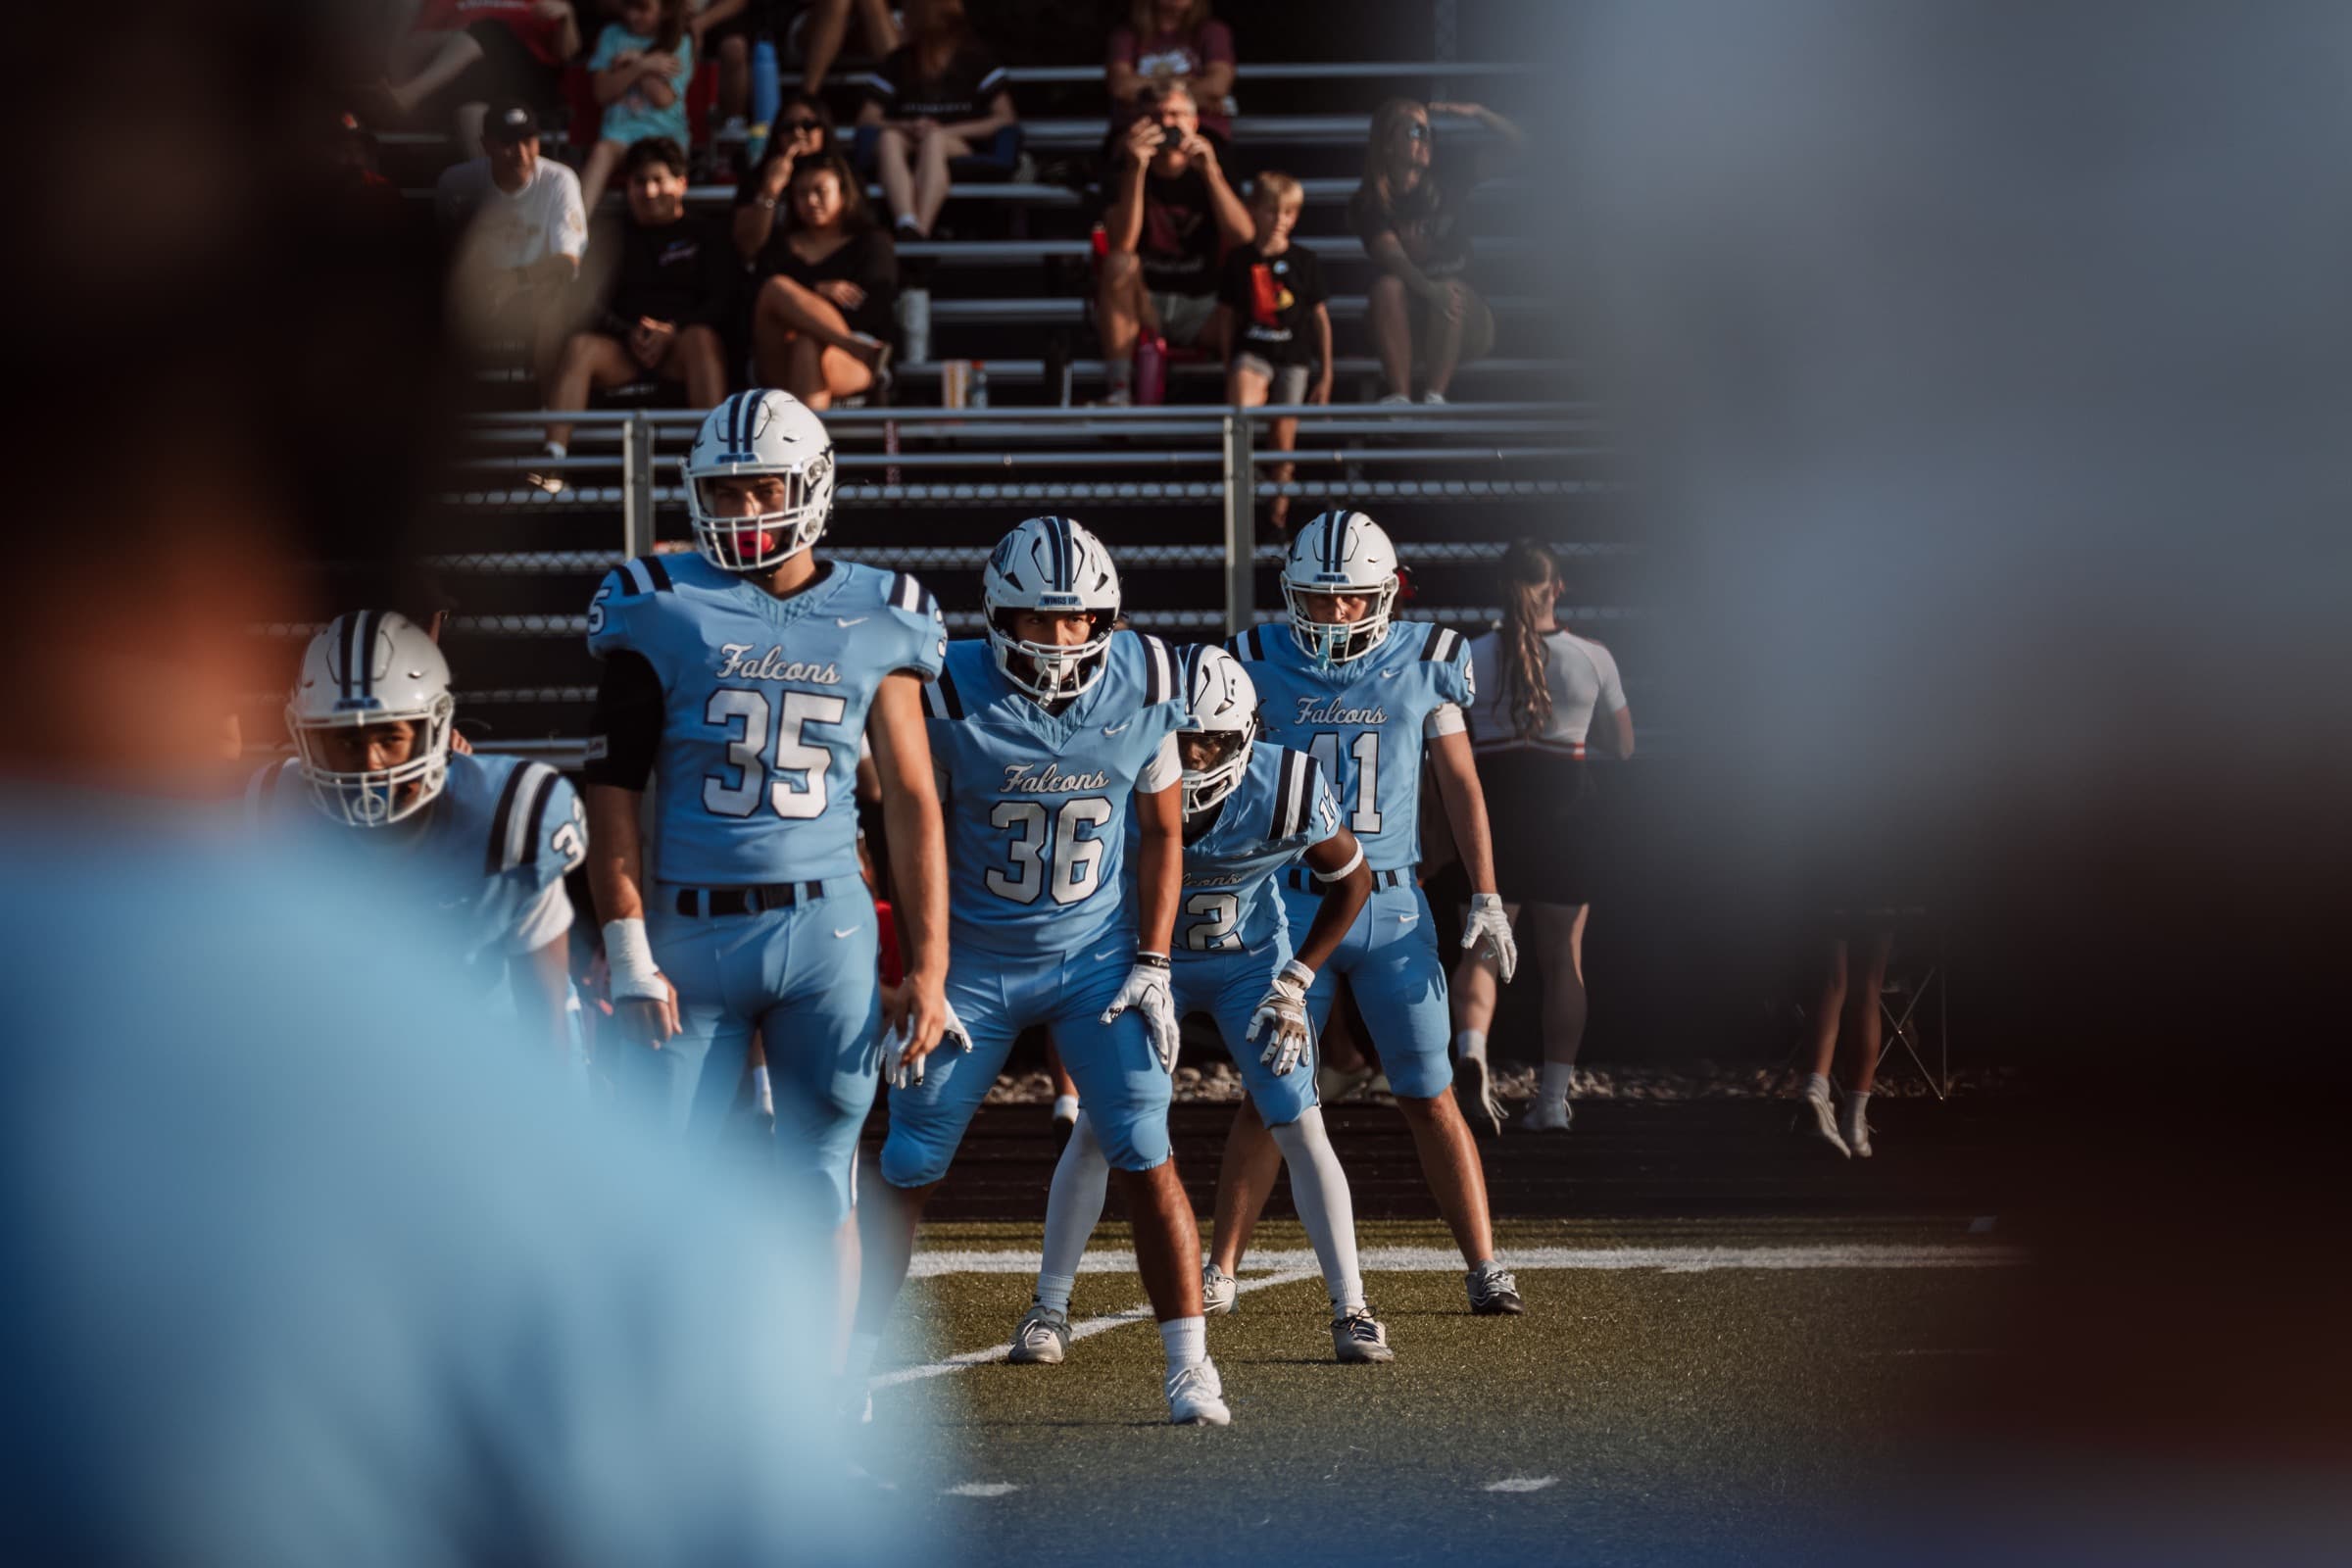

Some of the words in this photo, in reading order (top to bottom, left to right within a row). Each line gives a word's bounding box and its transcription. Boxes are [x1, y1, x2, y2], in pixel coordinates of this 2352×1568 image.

[1043, 595, 1067, 605] WINGS
[1068, 595, 1079, 605] UP
[716, 642, 842, 685] Falcons
[1293, 695, 1389, 725] Falcons
[702, 687, 848, 820] 35
[999, 761, 1110, 794] Falcons
[1307, 730, 1383, 834] 41
[984, 796, 1114, 906] 36
[1185, 892, 1246, 952] 2
